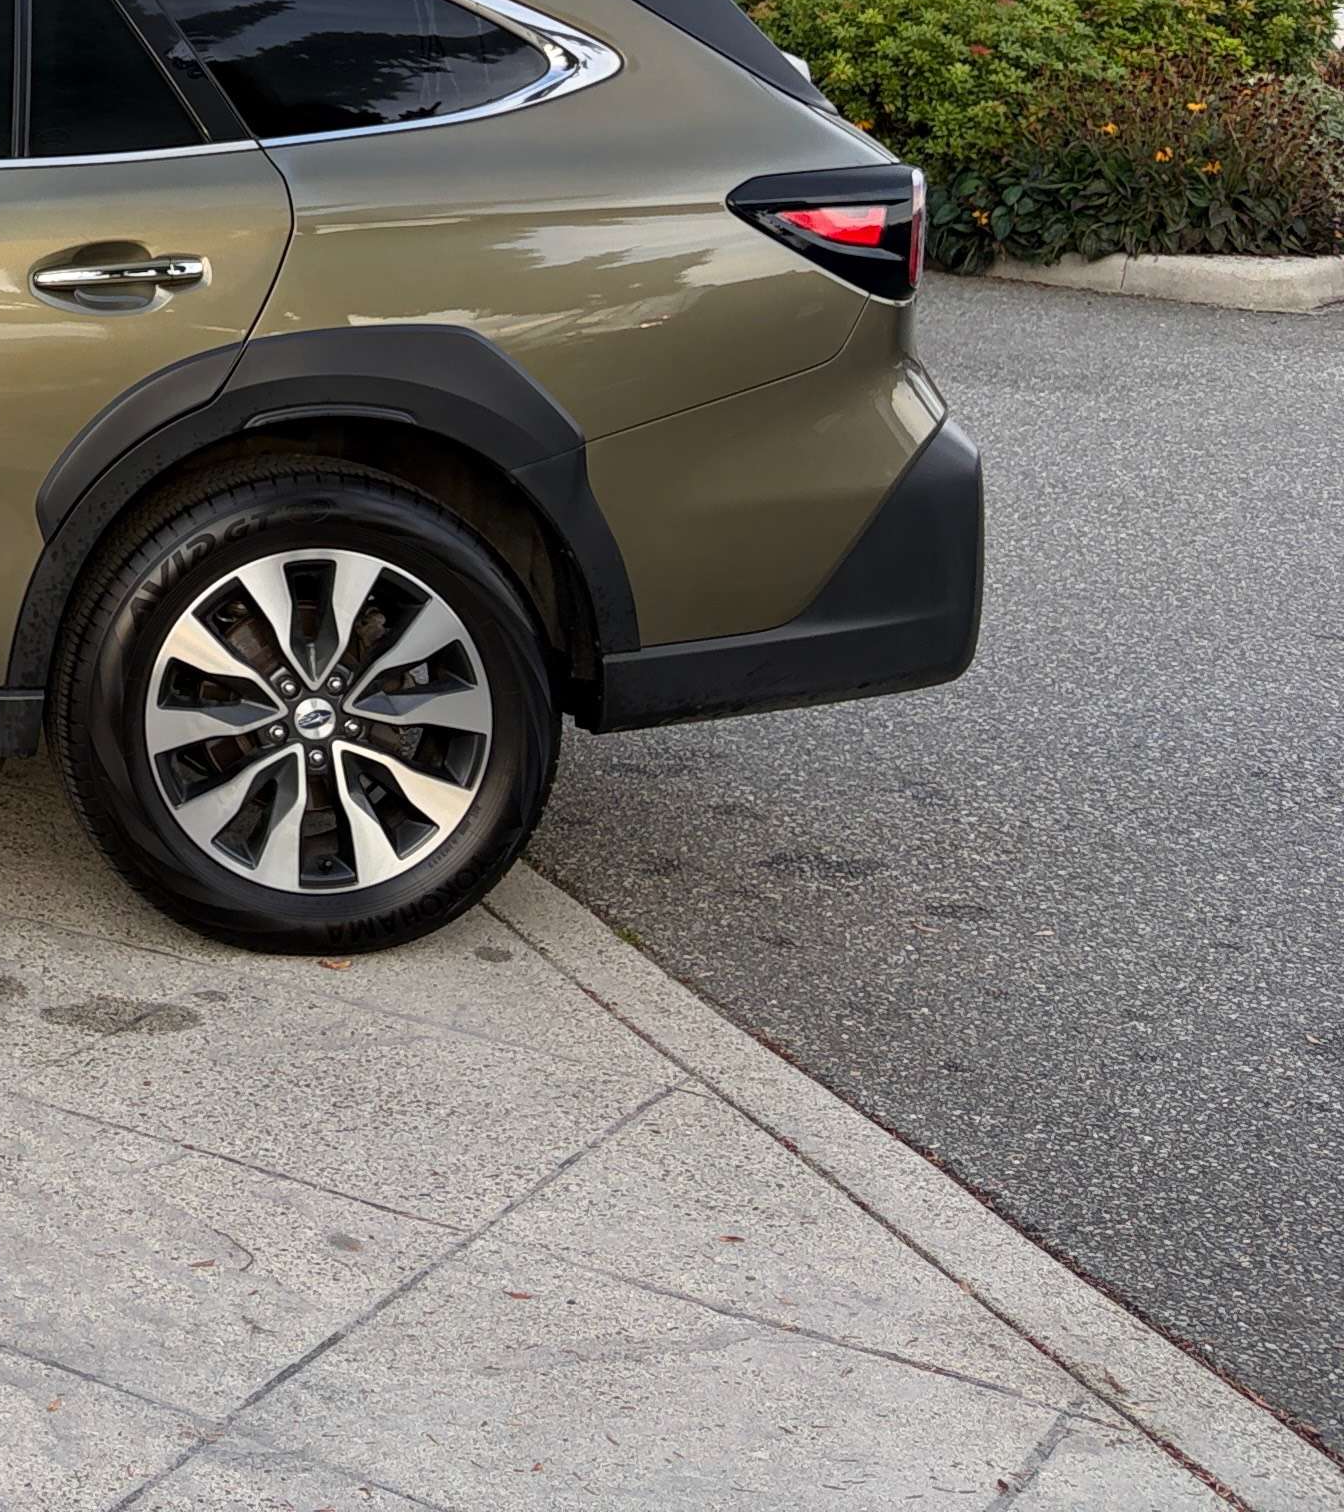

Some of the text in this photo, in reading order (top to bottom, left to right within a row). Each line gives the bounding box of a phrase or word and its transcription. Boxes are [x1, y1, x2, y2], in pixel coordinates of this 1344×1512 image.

[127, 511, 275, 629] AVID GT
[326, 852, 496, 945] YOKOHAMA
